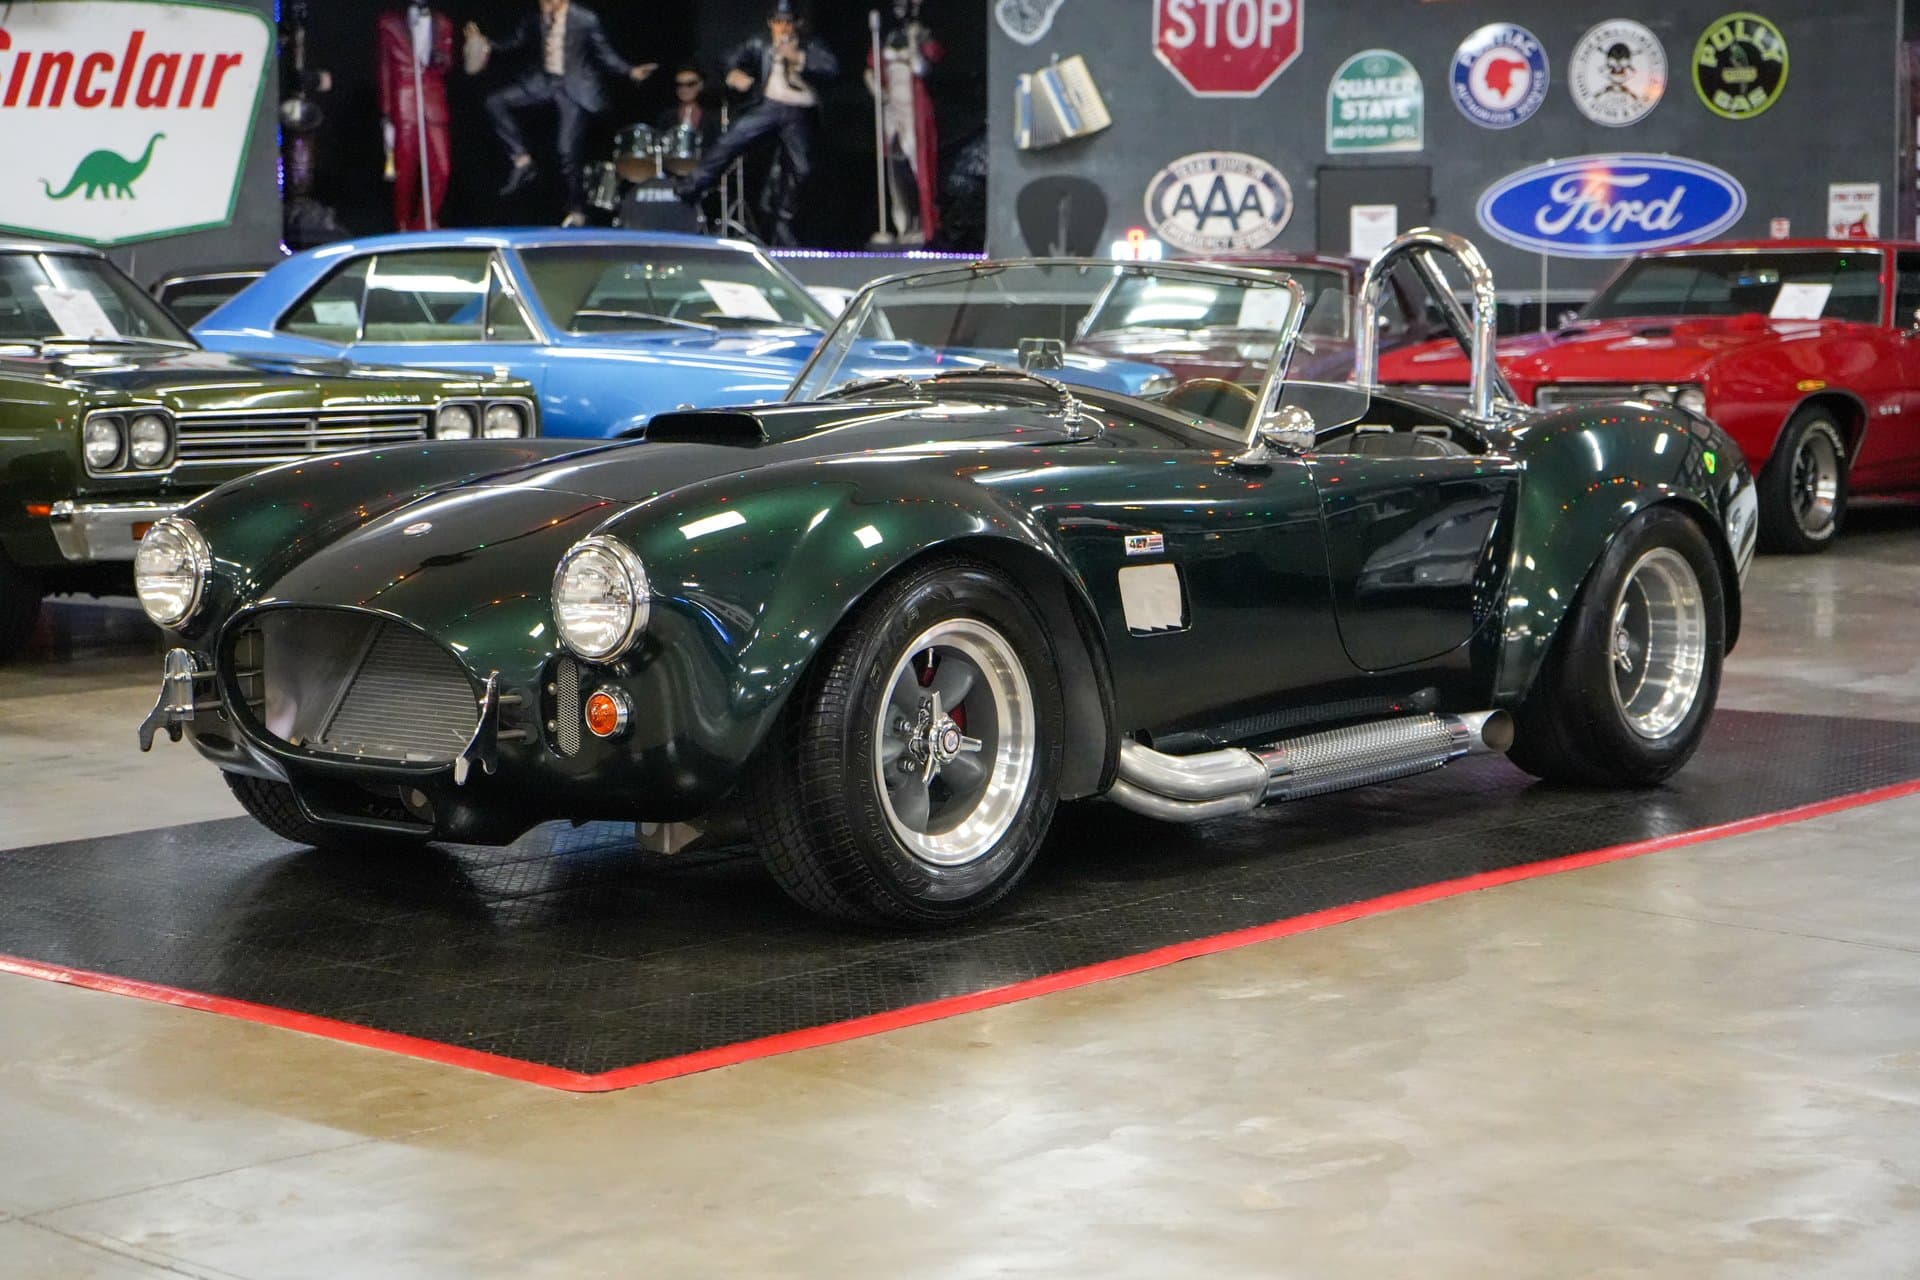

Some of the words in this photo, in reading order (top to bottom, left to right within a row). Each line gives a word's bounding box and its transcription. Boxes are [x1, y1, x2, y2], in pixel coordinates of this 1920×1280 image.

[1164, 0, 1293, 49] STOP
[1700, 19, 1783, 67] POLLY
[0, 26, 243, 109] inclair
[1340, 99, 1411, 120] STATE
[1172, 174, 1264, 231] AAA
[1535, 173, 1687, 236] Ford
[1129, 537, 1148, 549] 427
